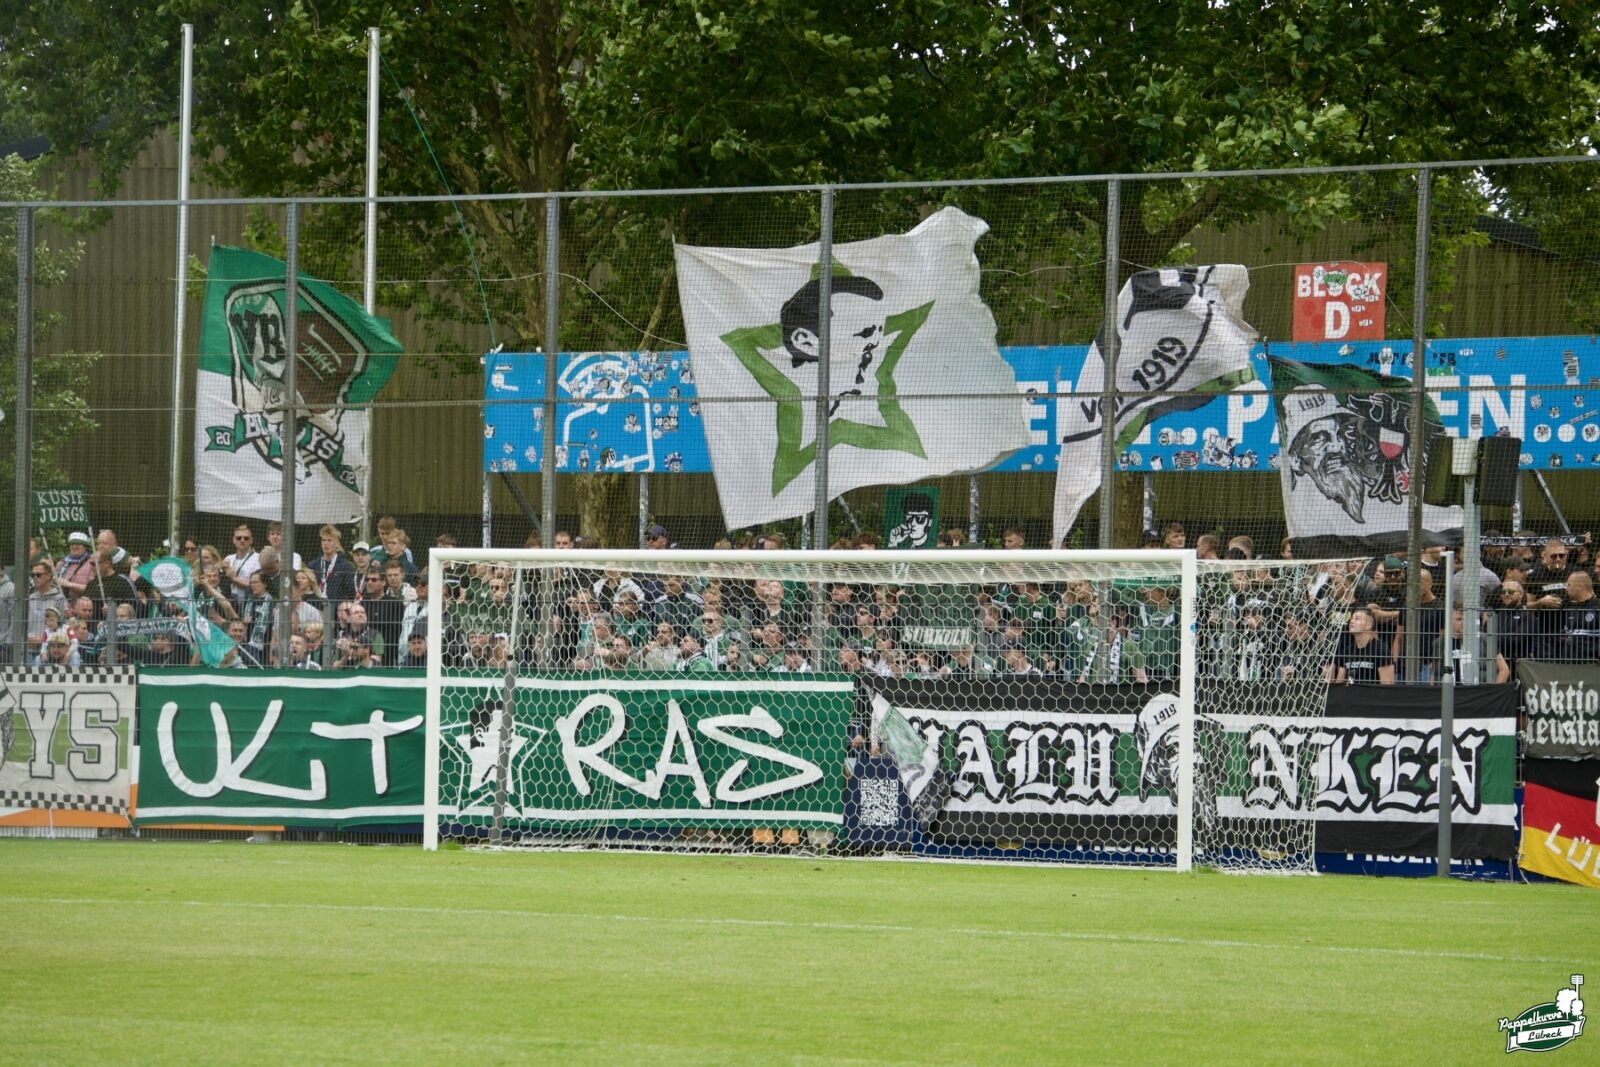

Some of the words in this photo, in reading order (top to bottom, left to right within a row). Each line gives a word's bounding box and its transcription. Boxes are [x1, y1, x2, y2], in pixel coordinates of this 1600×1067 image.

[1325, 301, 1350, 339] D
[1133, 336, 1187, 391] 1919
[1298, 392, 1326, 411] 1919
[1153, 703, 1177, 725] 1919
[20, 692, 119, 782] YS
